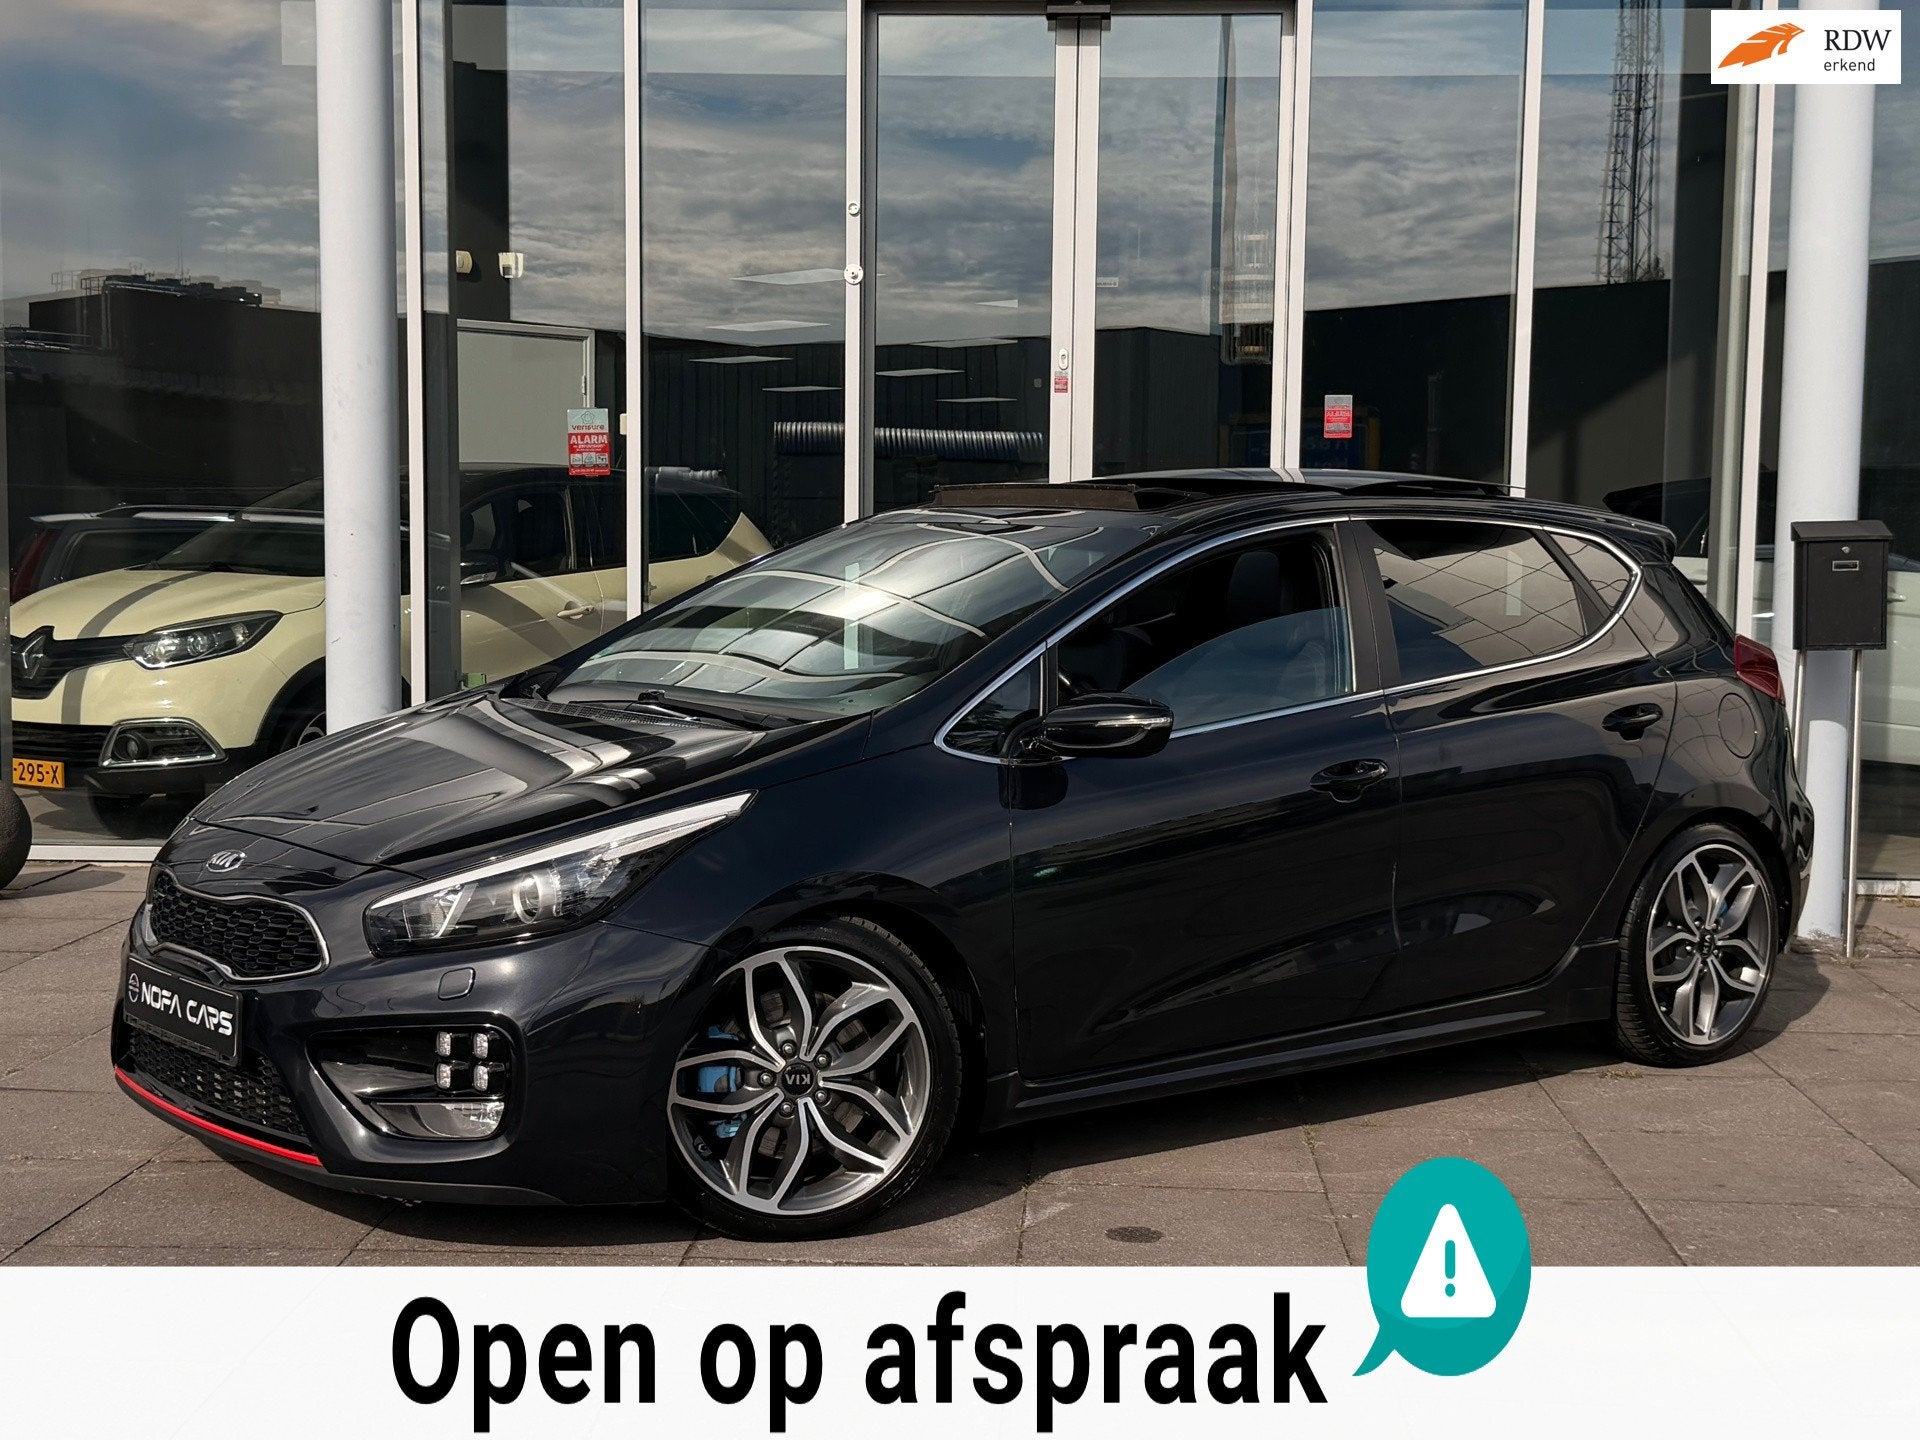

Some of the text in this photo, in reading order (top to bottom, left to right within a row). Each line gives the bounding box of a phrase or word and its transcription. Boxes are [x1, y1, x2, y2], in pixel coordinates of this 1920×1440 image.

[570, 434, 608, 444] ALARM
[141, 981, 182, 1018] NOFA
[785, 1073, 811, 1085] KIA
